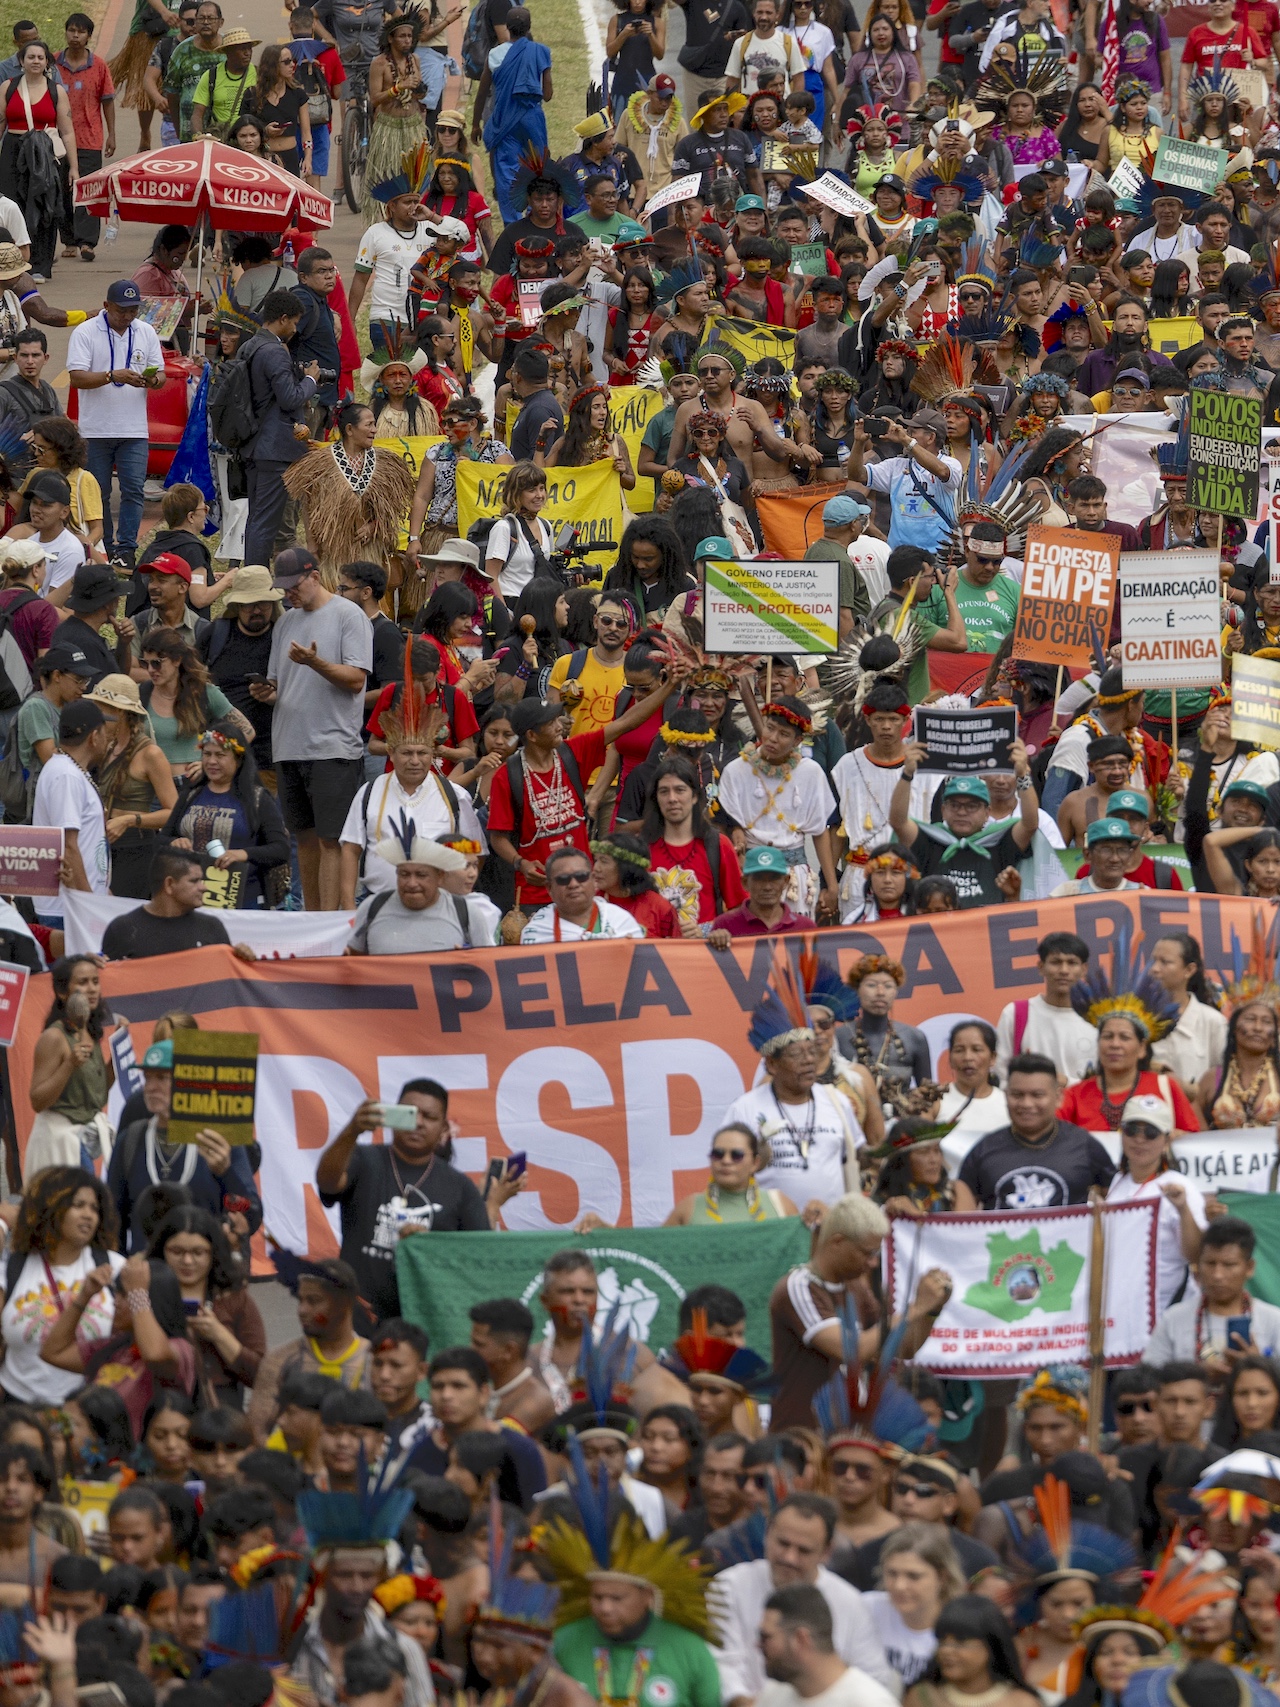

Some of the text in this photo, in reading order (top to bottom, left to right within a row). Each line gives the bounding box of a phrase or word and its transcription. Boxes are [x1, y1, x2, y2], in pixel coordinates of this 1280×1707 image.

[1164, 150, 1218, 171] OS BIOMAS
[1168, 140, 1218, 161] DEFENDER
[1160, 161, 1218, 182] E DEFENDER
[1170, 173, 1203, 189] A VIDA
[131, 181, 185, 198] KIBON
[224, 188, 276, 207] KIBON
[820, 176, 870, 212] DEMARCAÇÃO
[305, 197, 327, 217] KIBON
[1191, 390, 1261, 428] POVOS
[1191, 416, 1260, 445] INDÍGENAS
[1191, 435, 1258, 460] EM DEFESA DA
[1190, 448, 1258, 473] CONSTITUIÇÃO
[1207, 466, 1235, 486] E DA
[1197, 479, 1245, 514] VIDA
[1029, 542, 1112, 573] FLORESTA
[726, 569, 818, 578] GOVERNO FEDERAL
[710, 590, 739, 598] Fundação
[728, 580, 770, 588] MINISTÉRIO
[785, 582, 816, 590] JUSTIÇA
[1023, 562, 1112, 607] EM PÉ
[1123, 577, 1217, 599] DEMARCAÇÃO
[711, 603, 832, 614] TERRA PROTEGIDA
[1166, 609, 1176, 628] É
[965, 618, 993, 626] OKAS
[1017, 616, 1047, 641] NO
[1125, 638, 1218, 661] CAATINGA
[1234, 680, 1268, 696] ACESSO
[926, 718, 992, 730] POR UM CONSELHO
[926, 728, 1010, 743] NACIONAL DE EDUCAÇÃO
[927, 741, 994, 755] ESCOLAR INDÍGENA!
[11, 860, 39, 871] VIDA
[430, 944, 692, 1034] PELA
[987, 911, 1041, 990] E
[175, 1063, 255, 1082] ACESSO DIRETO
[173, 1090, 253, 1117] CLIMÁTICO
[1195, 1147, 1228, 1183] IÇÁ
[1234, 1154, 1244, 1175] E
[964, 1327, 1047, 1339] DE MULHERES
[942, 1341, 1034, 1353] DO ESTADO DO
